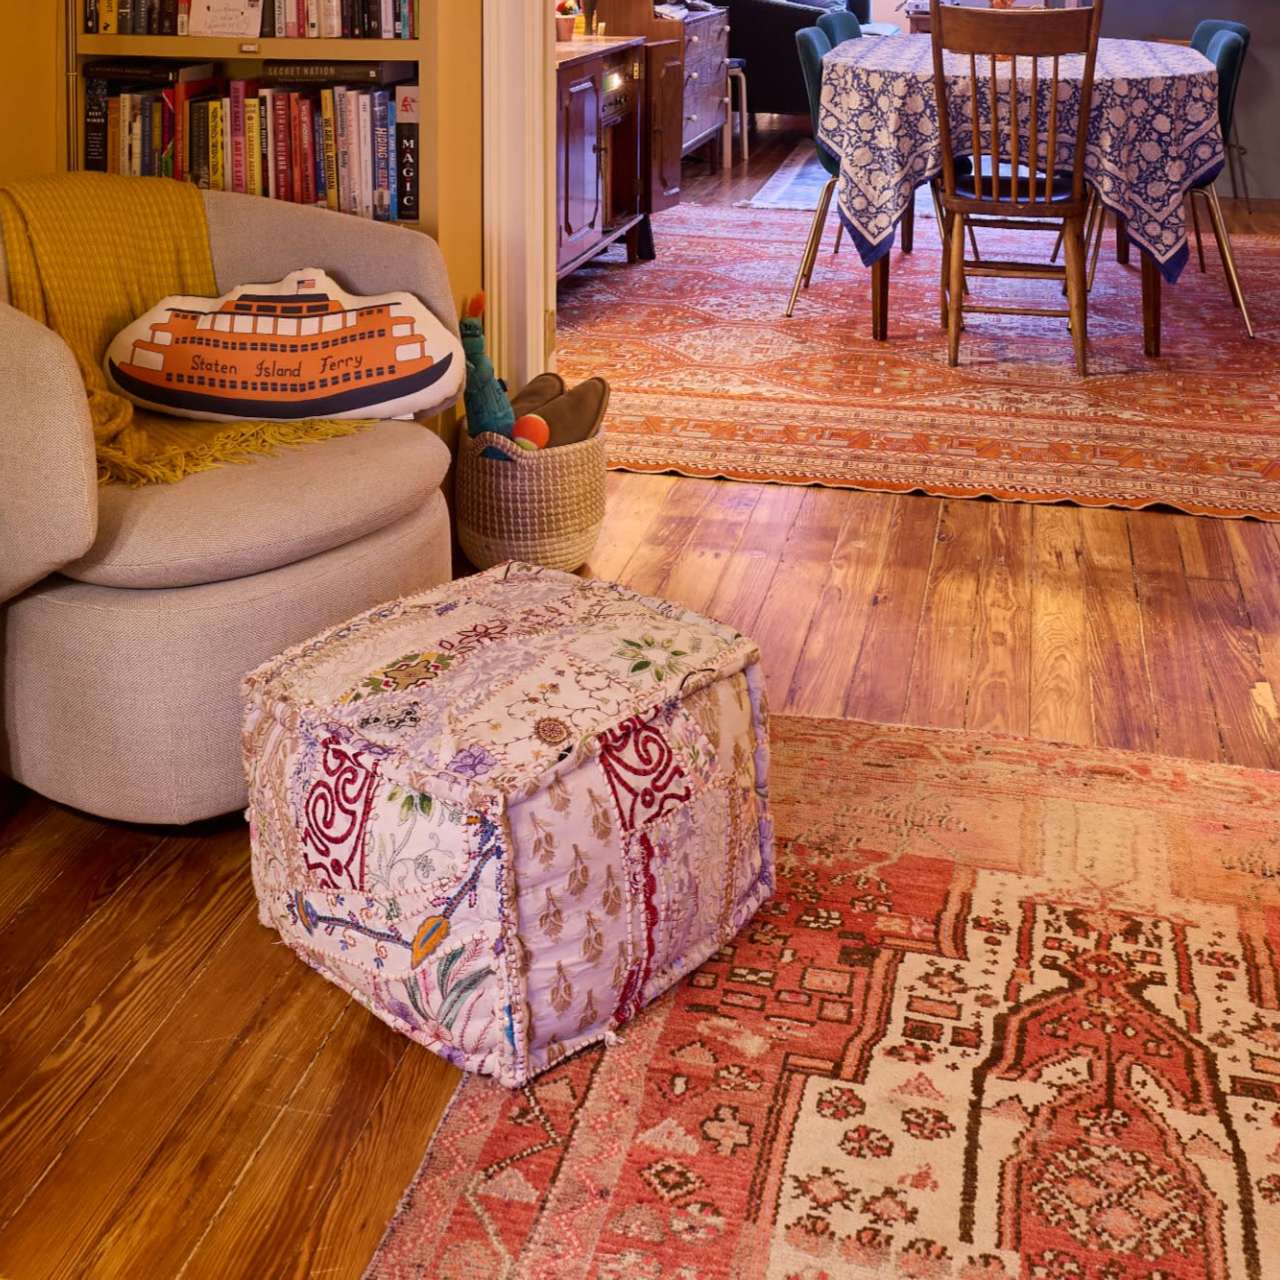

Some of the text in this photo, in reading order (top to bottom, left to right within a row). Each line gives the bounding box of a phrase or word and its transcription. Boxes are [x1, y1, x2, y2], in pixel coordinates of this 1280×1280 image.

[268, 65, 336, 77] SECRET NATION
[234, 140, 242, 158] ART
[376, 128, 388, 158] HIDING
[235, 170, 243, 188] LIFE
[325, 155, 334, 190] ARMENIAN
[402, 139, 415, 206] MAGIC
[190, 354, 364, 378] Staten Island Ferry
